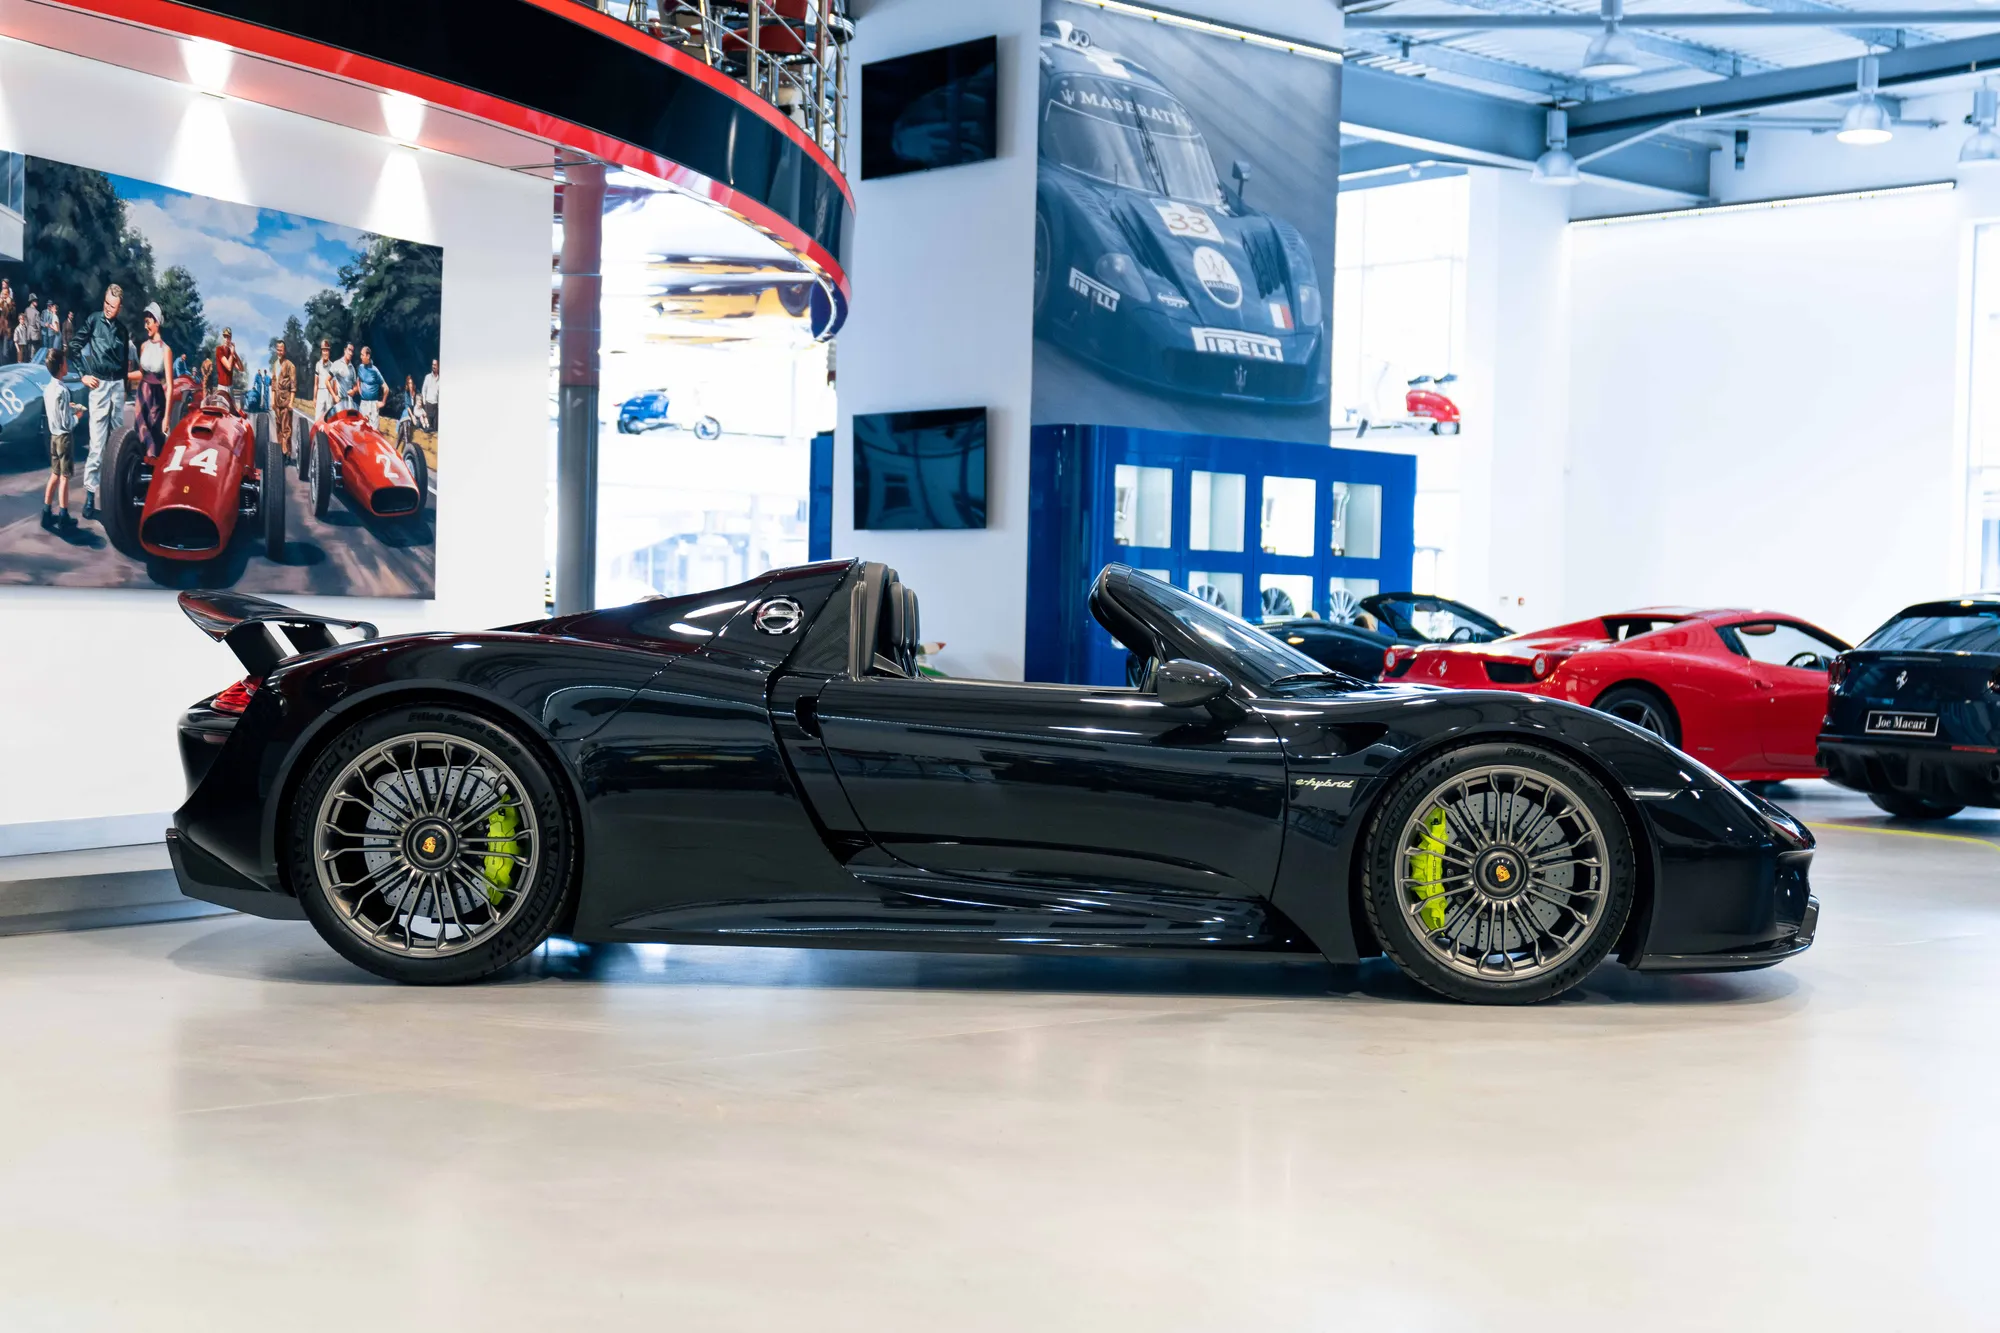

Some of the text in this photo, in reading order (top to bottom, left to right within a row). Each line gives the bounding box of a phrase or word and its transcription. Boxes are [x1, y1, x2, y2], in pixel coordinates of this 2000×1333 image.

[1080, 91, 1181, 126] MASERATI
[1168, 212, 1208, 234] 33
[1191, 327, 1284, 362] PIRELLI
[0, 388, 24, 415] 18
[163, 445, 219, 477] 14
[376, 454, 399, 478] 2
[1876, 715, 1928, 730] Joe Macari
[294, 750, 340, 839] MICHELIN
[1379, 778, 1426, 848] MICHELIN
[512, 849, 558, 938] MICHELIN
